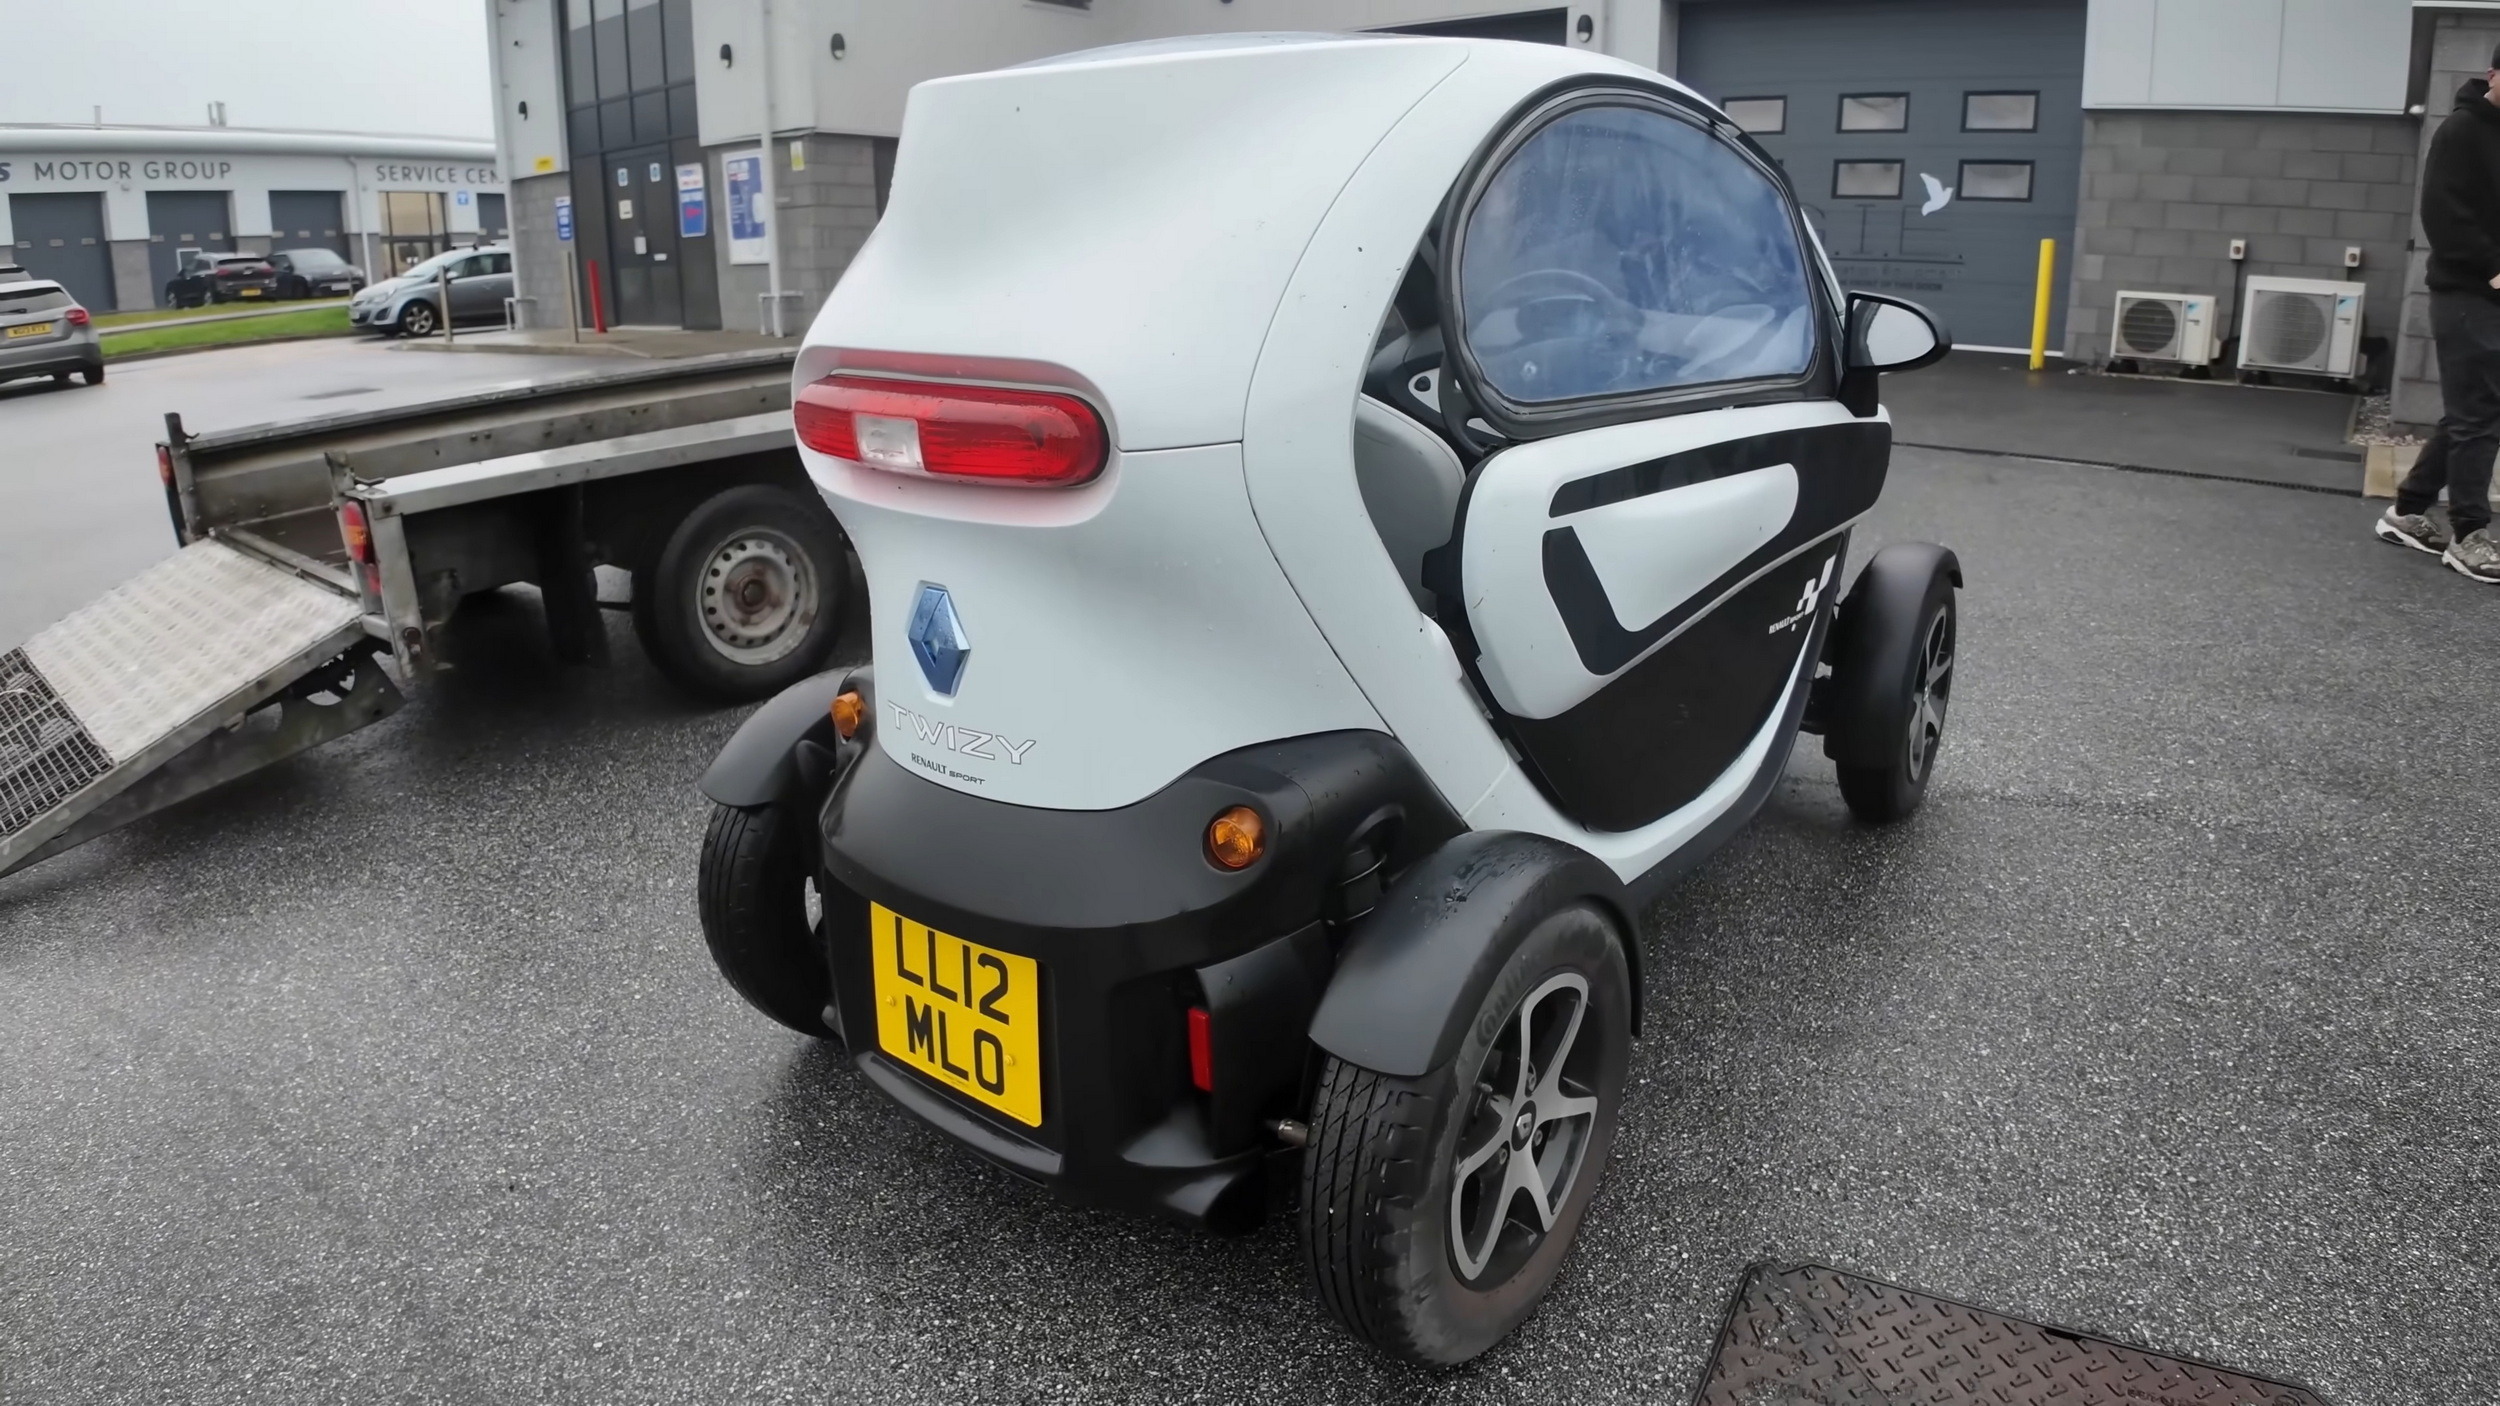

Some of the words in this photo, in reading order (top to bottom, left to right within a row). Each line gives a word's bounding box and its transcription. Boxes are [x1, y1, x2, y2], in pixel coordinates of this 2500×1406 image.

[34, 161, 131, 181] MOTOR
[144, 161, 231, 181] GROUP
[376, 165, 457, 183] SERVICE
[887, 700, 1037, 765] TWIZY
[911, 752, 948, 776] RENAULT
[948, 770, 986, 786] SPORT
[894, 915, 1011, 1027] LL12
[904, 993, 1006, 1097] MLO
